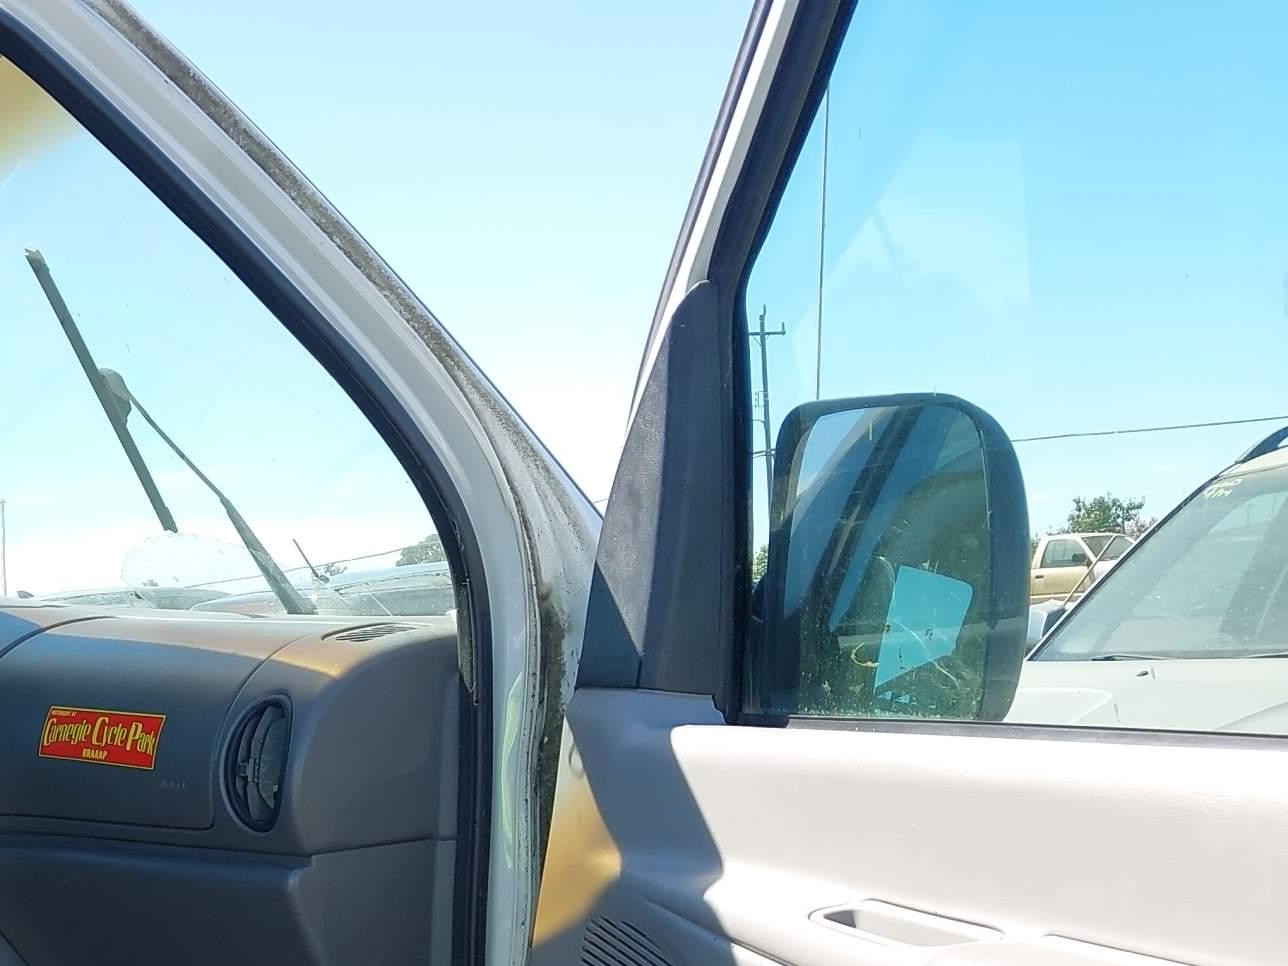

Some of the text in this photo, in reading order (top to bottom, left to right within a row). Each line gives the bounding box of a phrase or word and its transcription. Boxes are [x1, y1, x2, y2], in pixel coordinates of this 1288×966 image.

[44, 716, 155, 755] Carnegie Cycle Park
